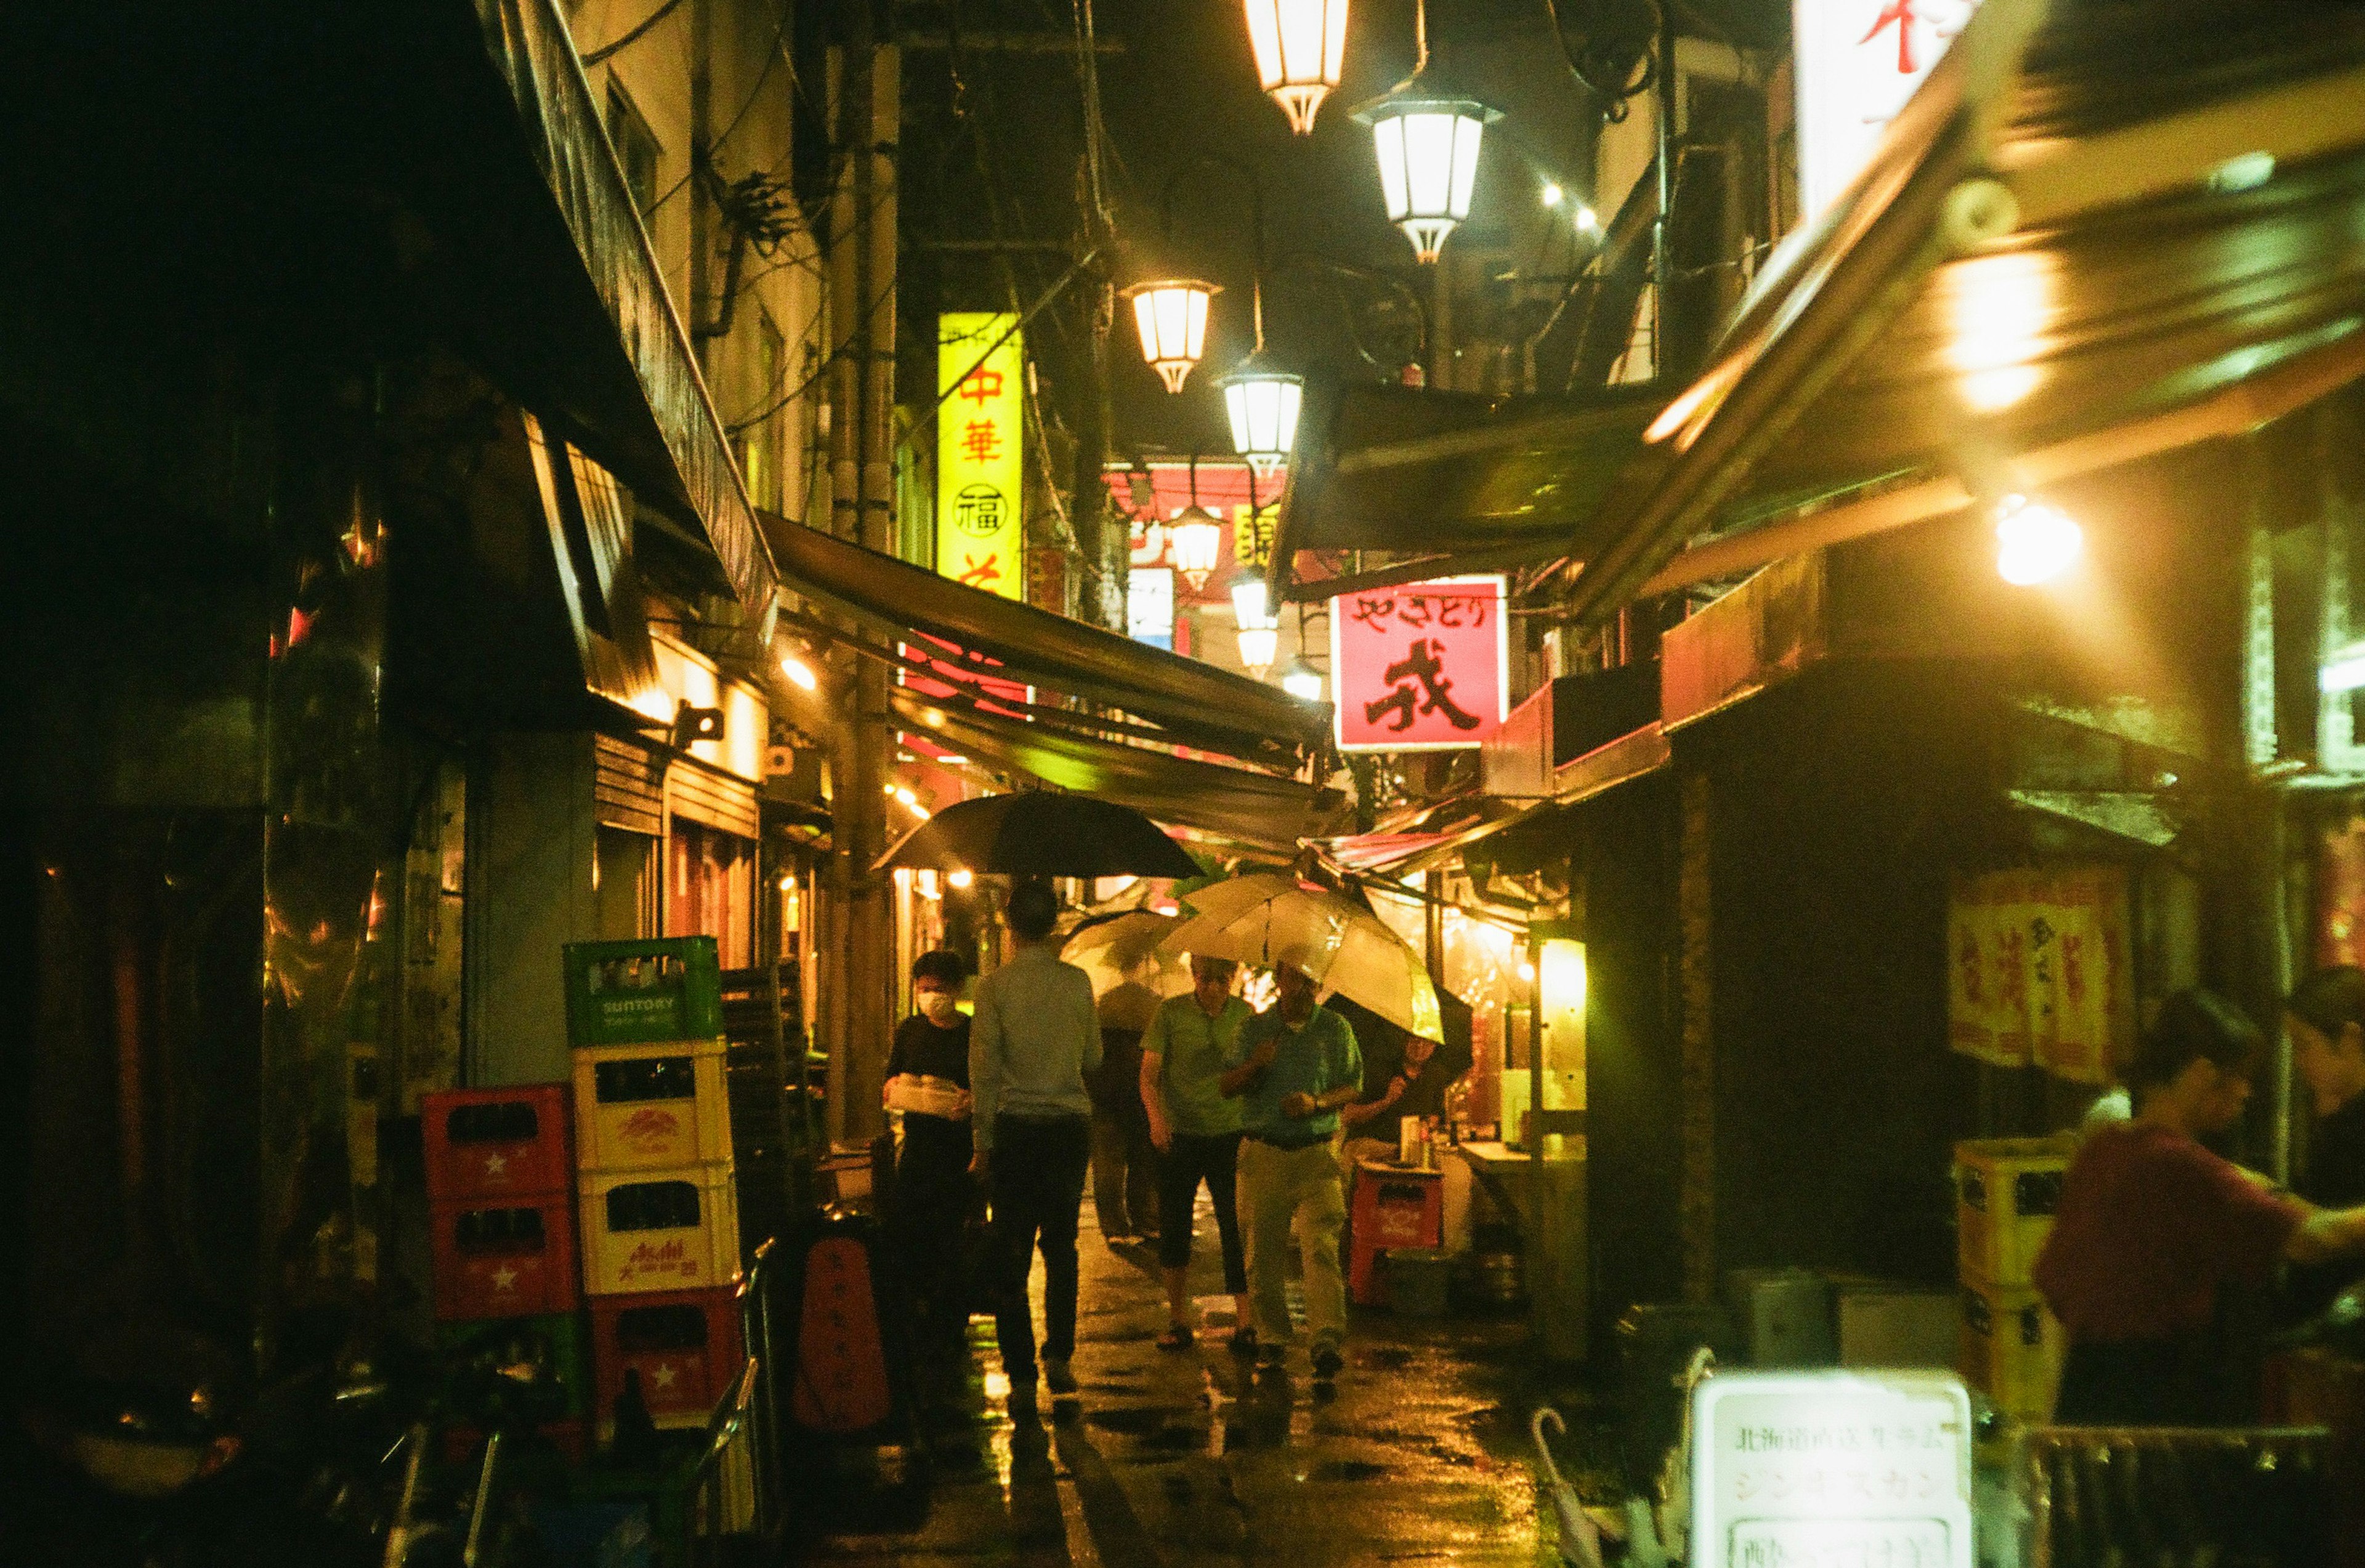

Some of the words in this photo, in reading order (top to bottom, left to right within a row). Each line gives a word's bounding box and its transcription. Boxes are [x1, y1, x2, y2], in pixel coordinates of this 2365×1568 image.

[1352, 596, 1486, 634] やきとり
[603, 997, 673, 1013] SUNTORY
